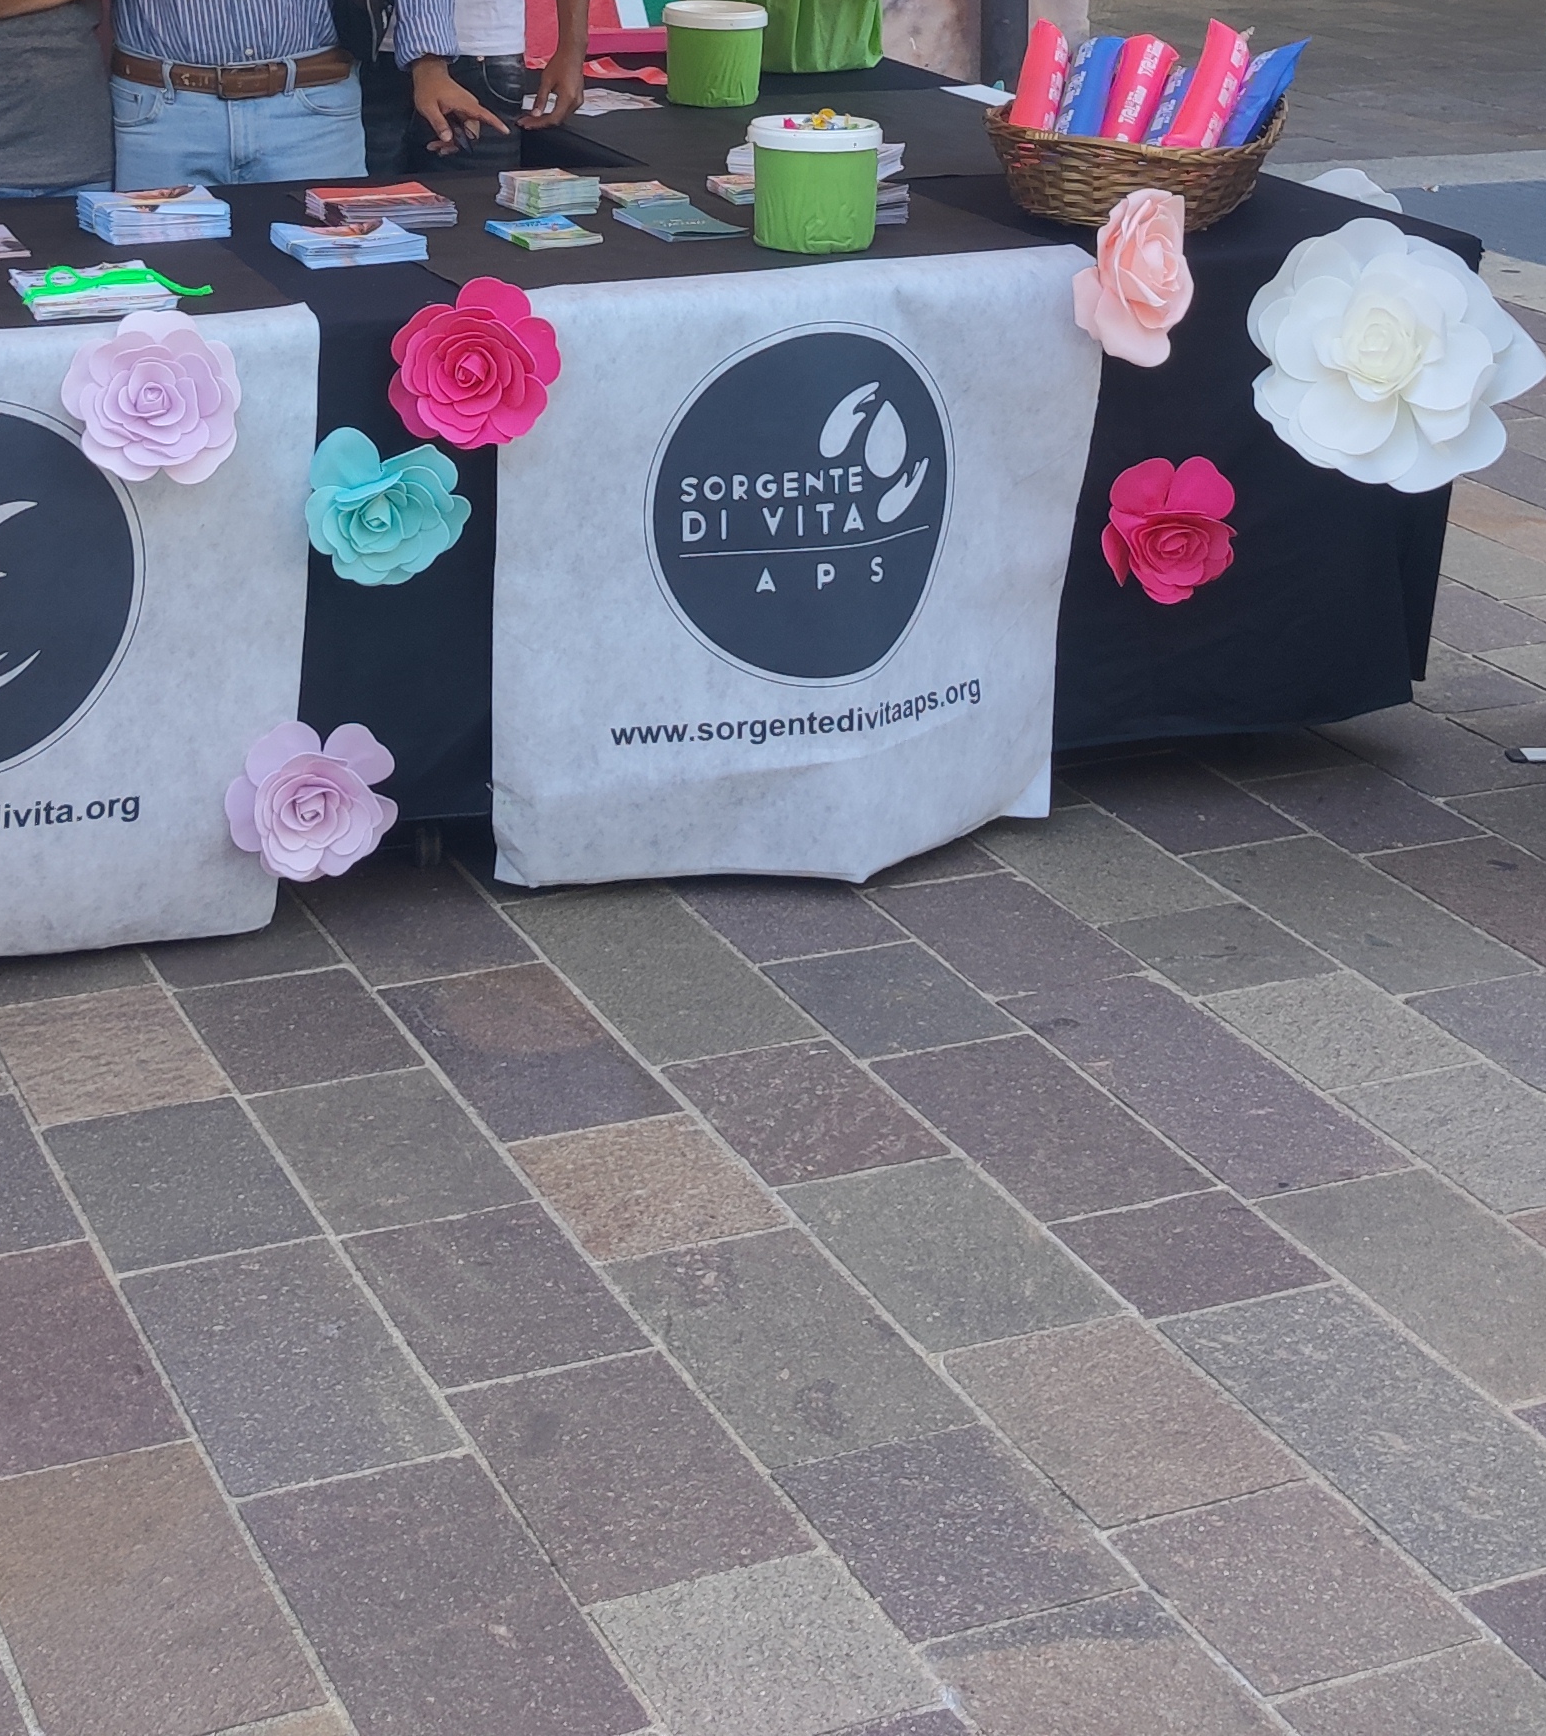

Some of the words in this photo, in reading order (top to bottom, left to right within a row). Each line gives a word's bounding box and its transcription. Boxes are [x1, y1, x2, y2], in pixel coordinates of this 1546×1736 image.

[680, 466, 863, 502] SORGENTE
[681, 508, 728, 543] DI
[762, 502, 866, 537] VITA
[611, 677, 982, 745] www.sorgentedivitaaps.org
